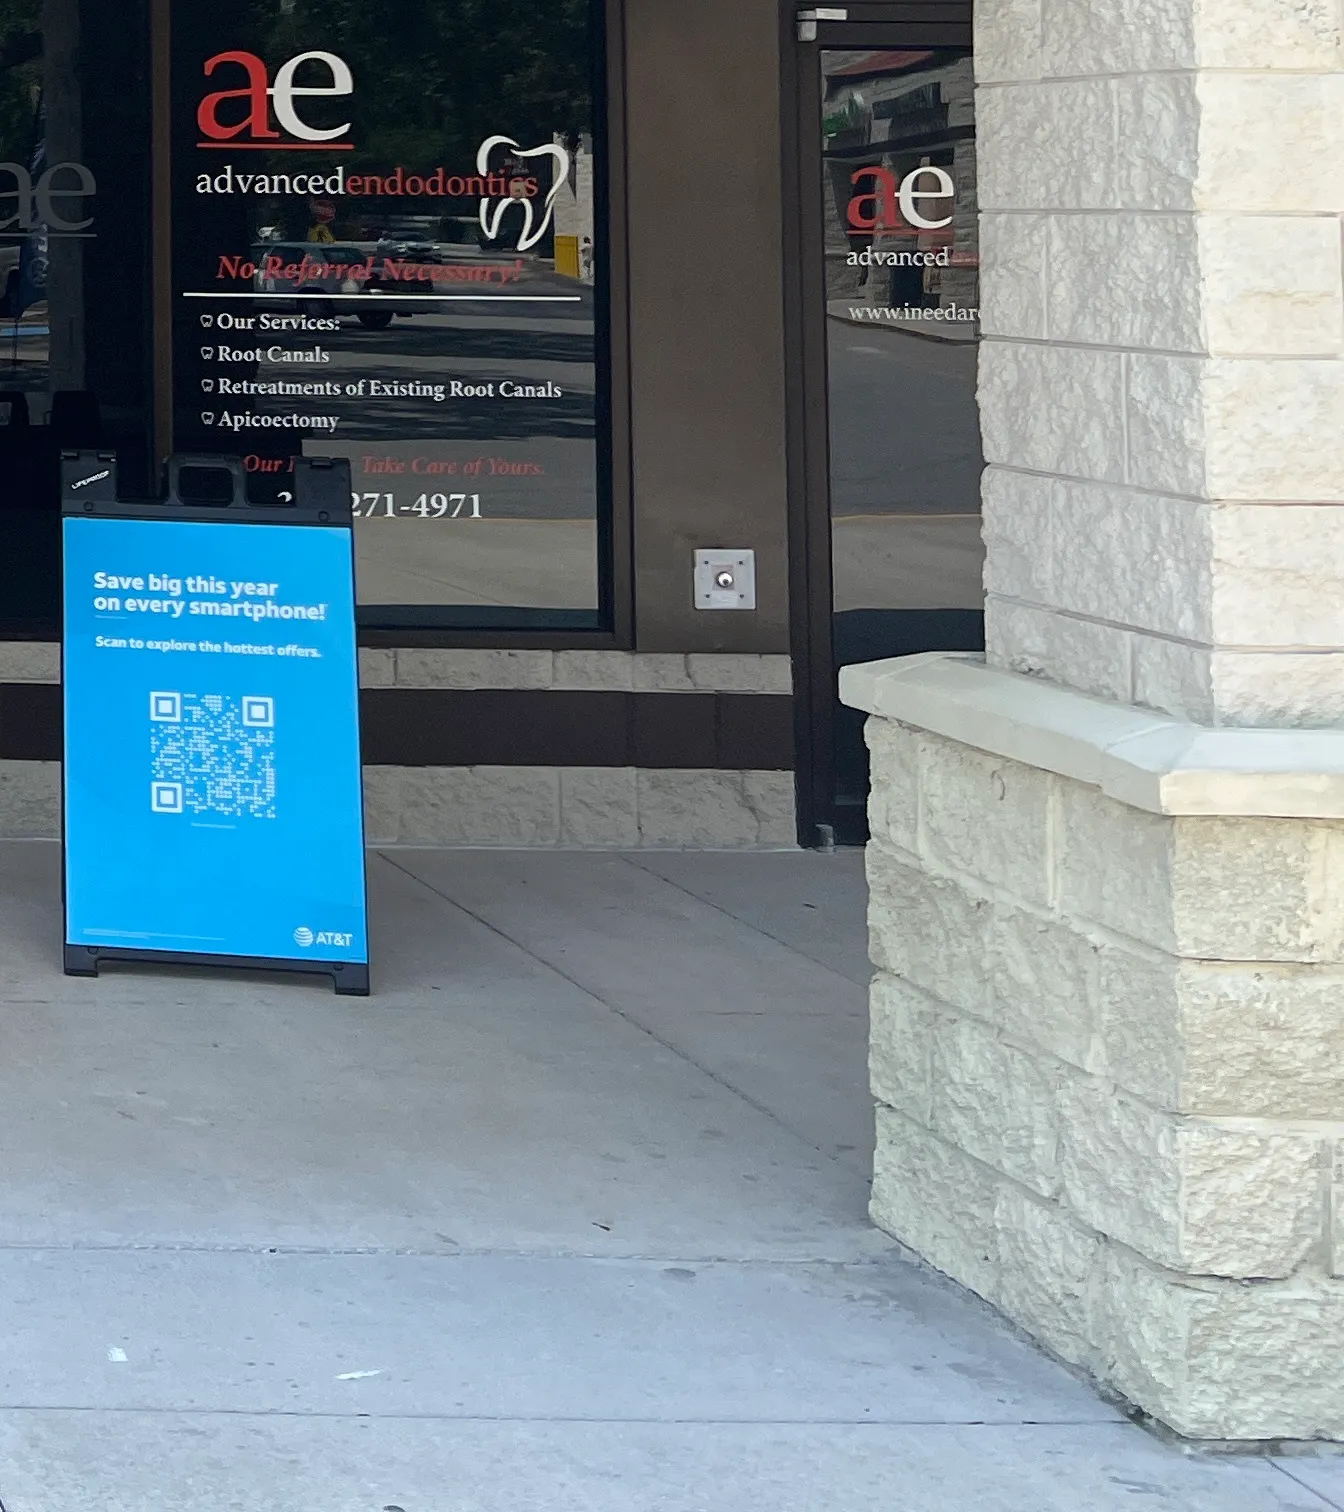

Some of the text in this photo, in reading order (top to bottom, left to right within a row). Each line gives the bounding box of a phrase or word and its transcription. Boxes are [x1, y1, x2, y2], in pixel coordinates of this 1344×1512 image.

[197, 51, 354, 141] ae
[847, 166, 955, 229] ae
[216, 255, 524, 288] No Referral Necessary!
[217, 313, 341, 331] Our Services:
[217, 346, 330, 363] Root Canals
[218, 378, 562, 401] Retreatments of Existing Root Canals
[217, 411, 340, 432] Apicoectomy
[243, 455, 282, 472] Our
[362, 456, 405, 474] Take
[412, 457, 458, 474] Care
[463, 458, 482, 477] of
[94, 572, 279, 599] Save big this year
[93, 597, 326, 622] on every smartphone!
[95, 636, 323, 658] Scan to explore the hottest offers.
[315, 931, 353, 947] AT&T
